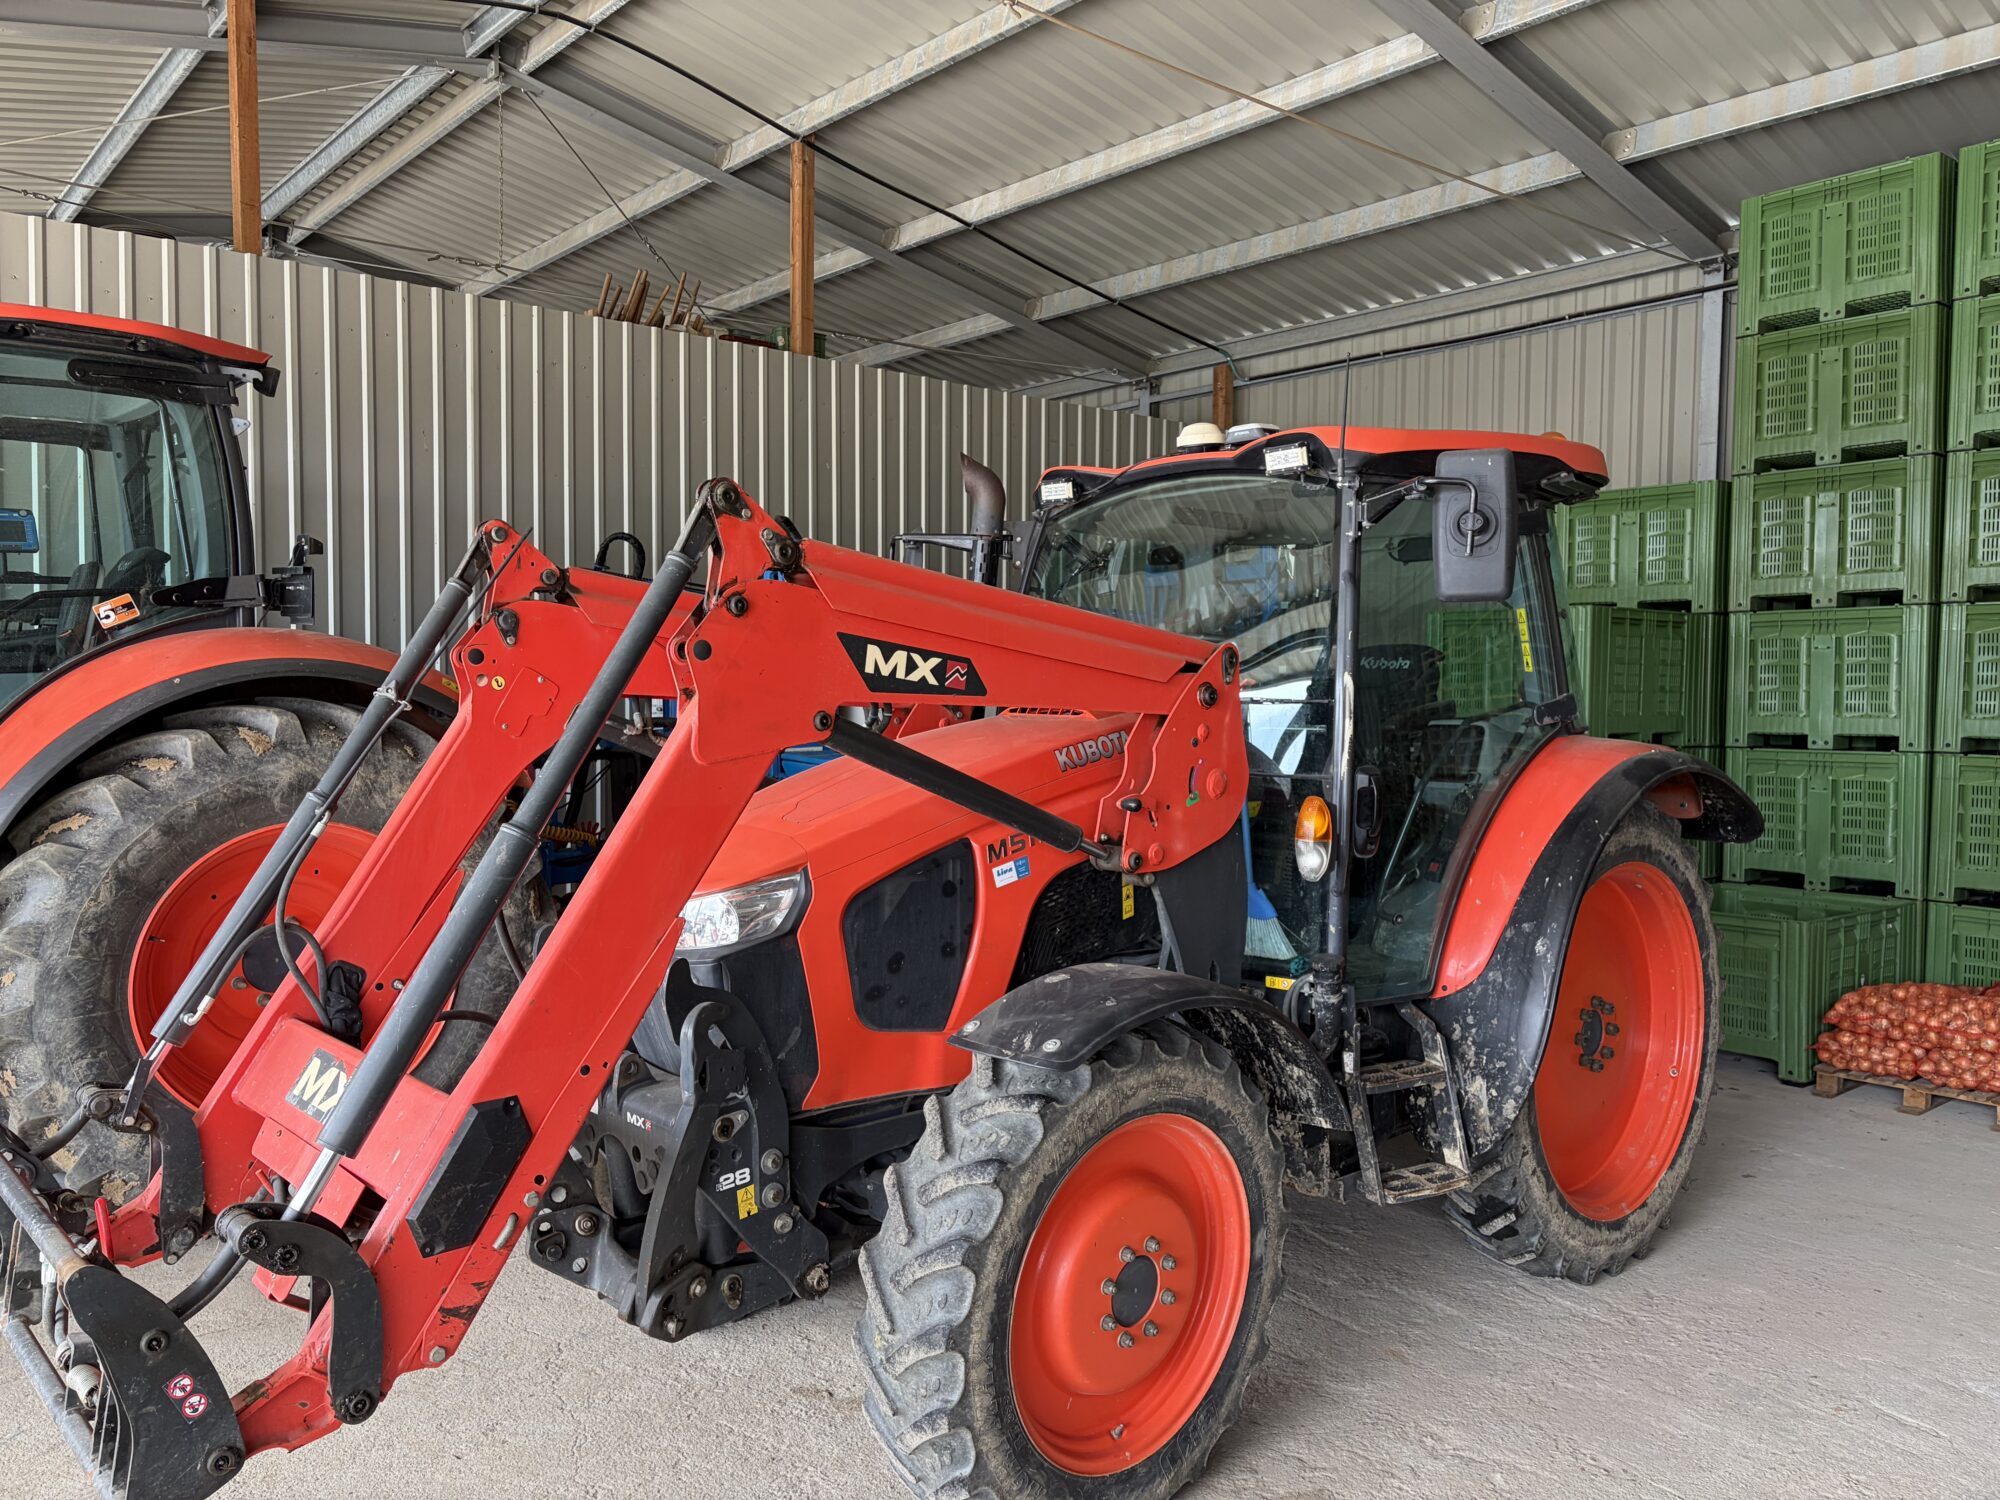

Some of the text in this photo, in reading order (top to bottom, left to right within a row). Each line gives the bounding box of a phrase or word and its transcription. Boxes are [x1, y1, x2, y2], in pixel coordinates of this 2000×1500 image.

[99, 604, 116, 624] 5
[864, 644, 943, 686] MX
[1360, 656, 1410, 670] Kubota
[626, 1111, 645, 1129] MX
